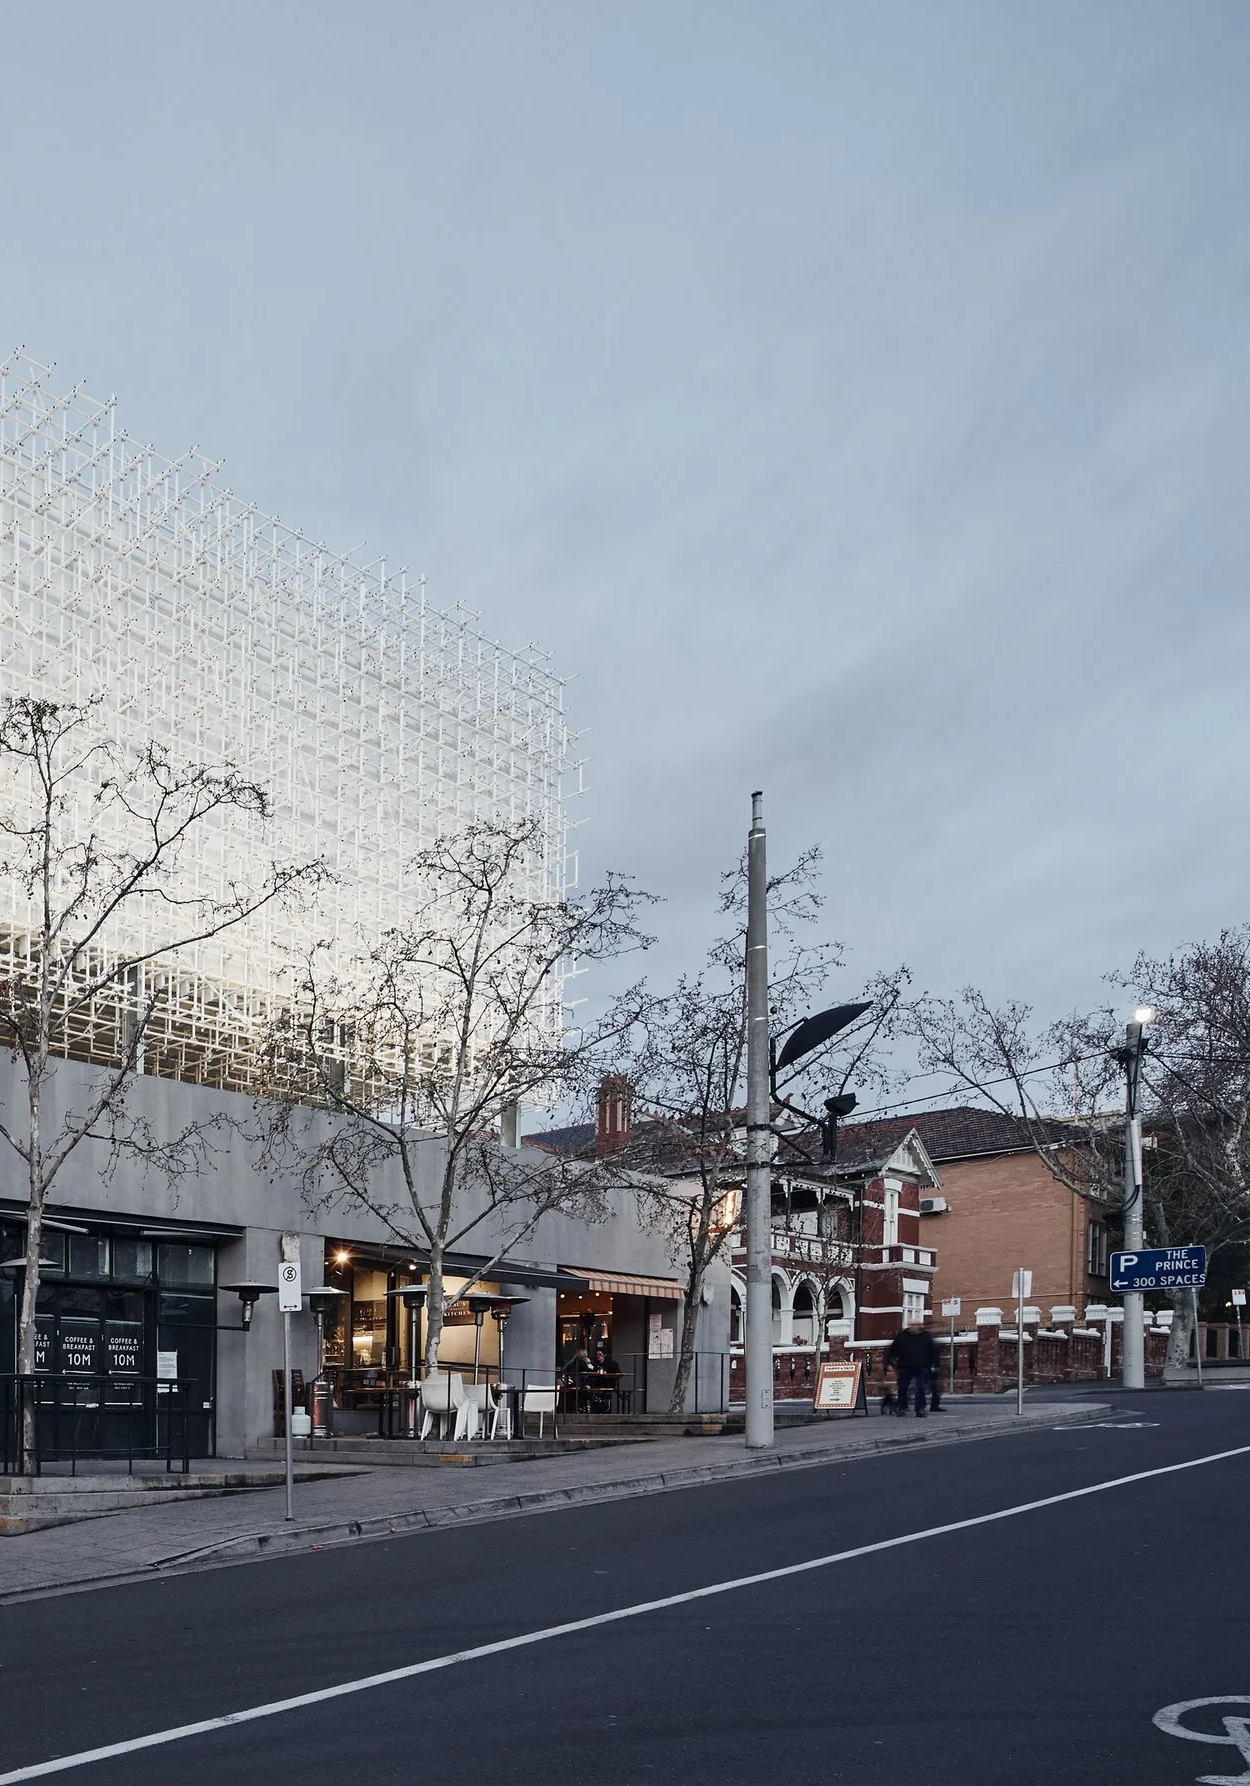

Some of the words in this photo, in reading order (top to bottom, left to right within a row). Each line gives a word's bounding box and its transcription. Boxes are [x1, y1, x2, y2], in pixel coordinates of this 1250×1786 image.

[1166, 1250, 1188, 1259] THE
[1120, 1255, 1138, 1272] P
[1155, 1259, 1199, 1271] PRINCE
[1133, 1277, 1155, 1287] 300
[1160, 1274, 1206, 1285] SPACES
[64, 1336, 88, 1344] COFFEE
[110, 1337, 132, 1345] COFFEE
[62, 1343, 96, 1351] BREAKFAST
[68, 1353, 91, 1366] 10M
[113, 1354, 135, 1366] 10M
